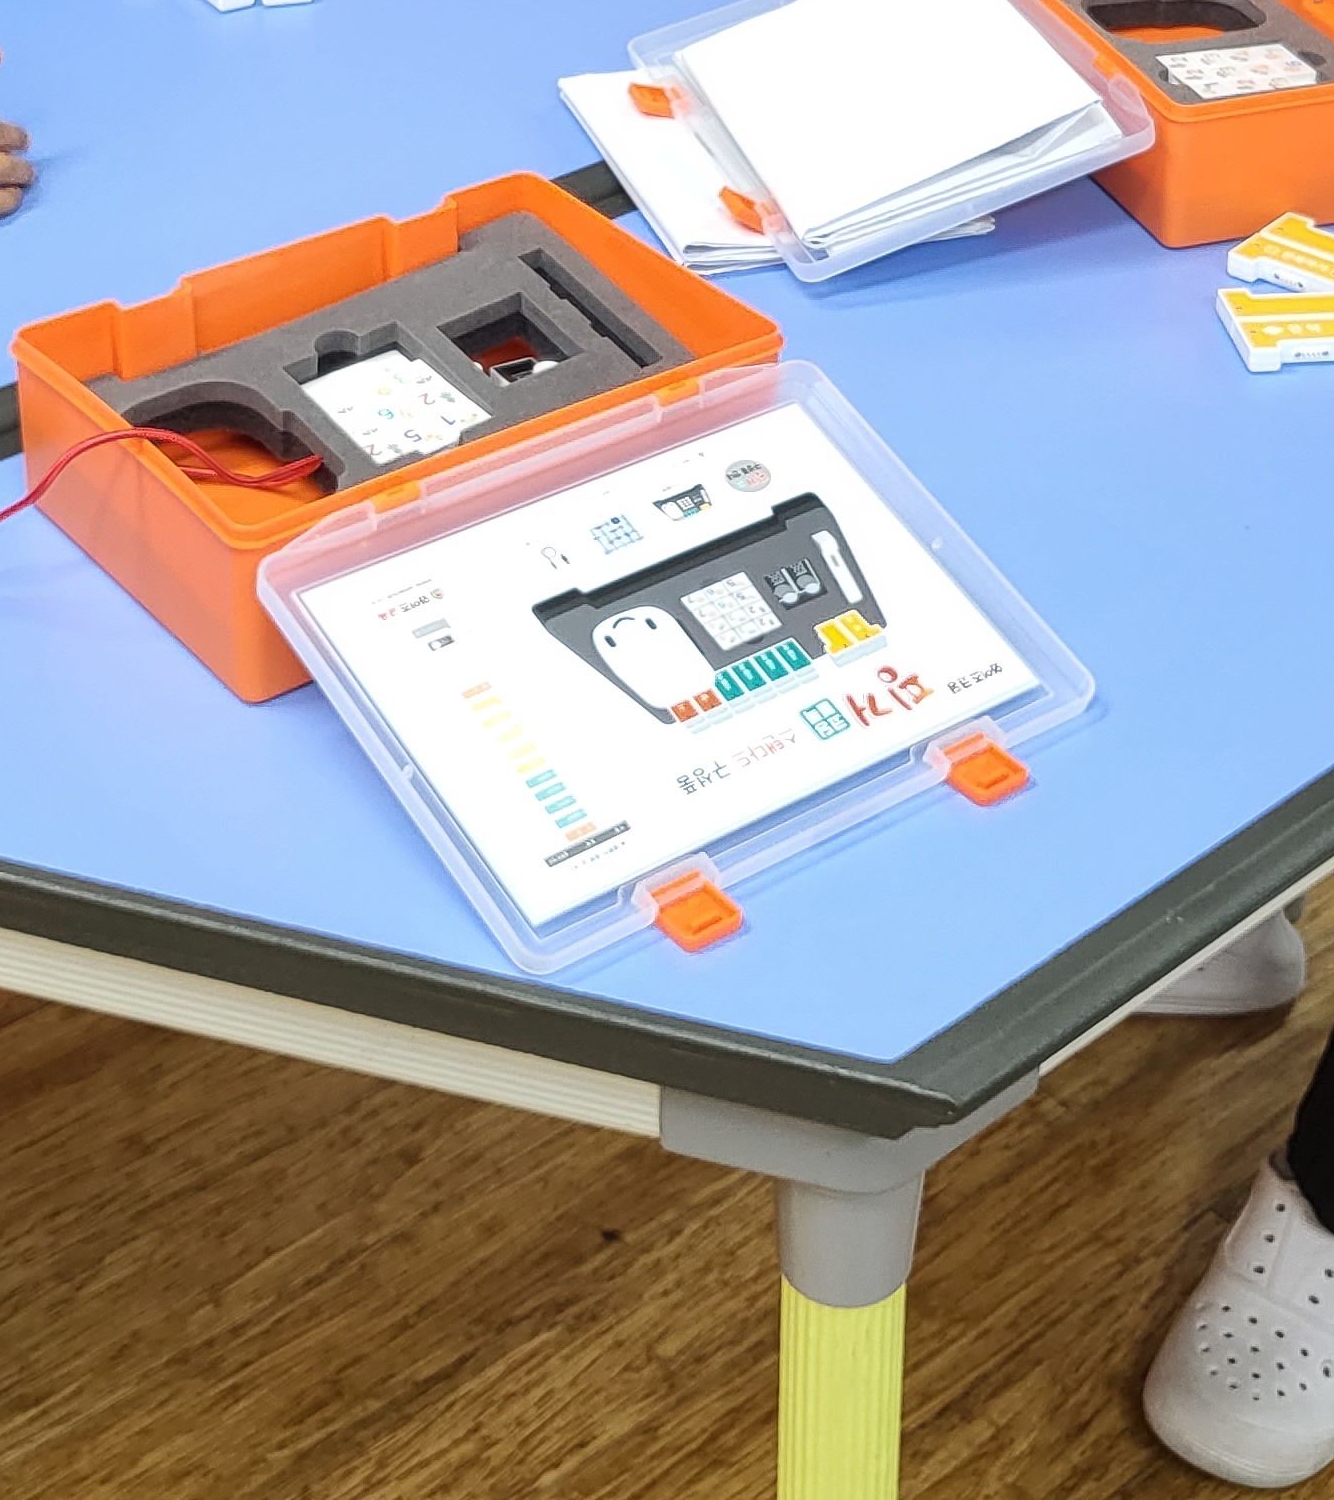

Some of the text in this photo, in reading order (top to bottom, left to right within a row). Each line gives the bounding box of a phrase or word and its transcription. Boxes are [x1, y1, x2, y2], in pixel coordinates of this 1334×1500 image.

[844, 665, 934, 727] 핑거
[731, 728, 796, 768] 스탠다드
[677, 761, 731, 795] 구성품
